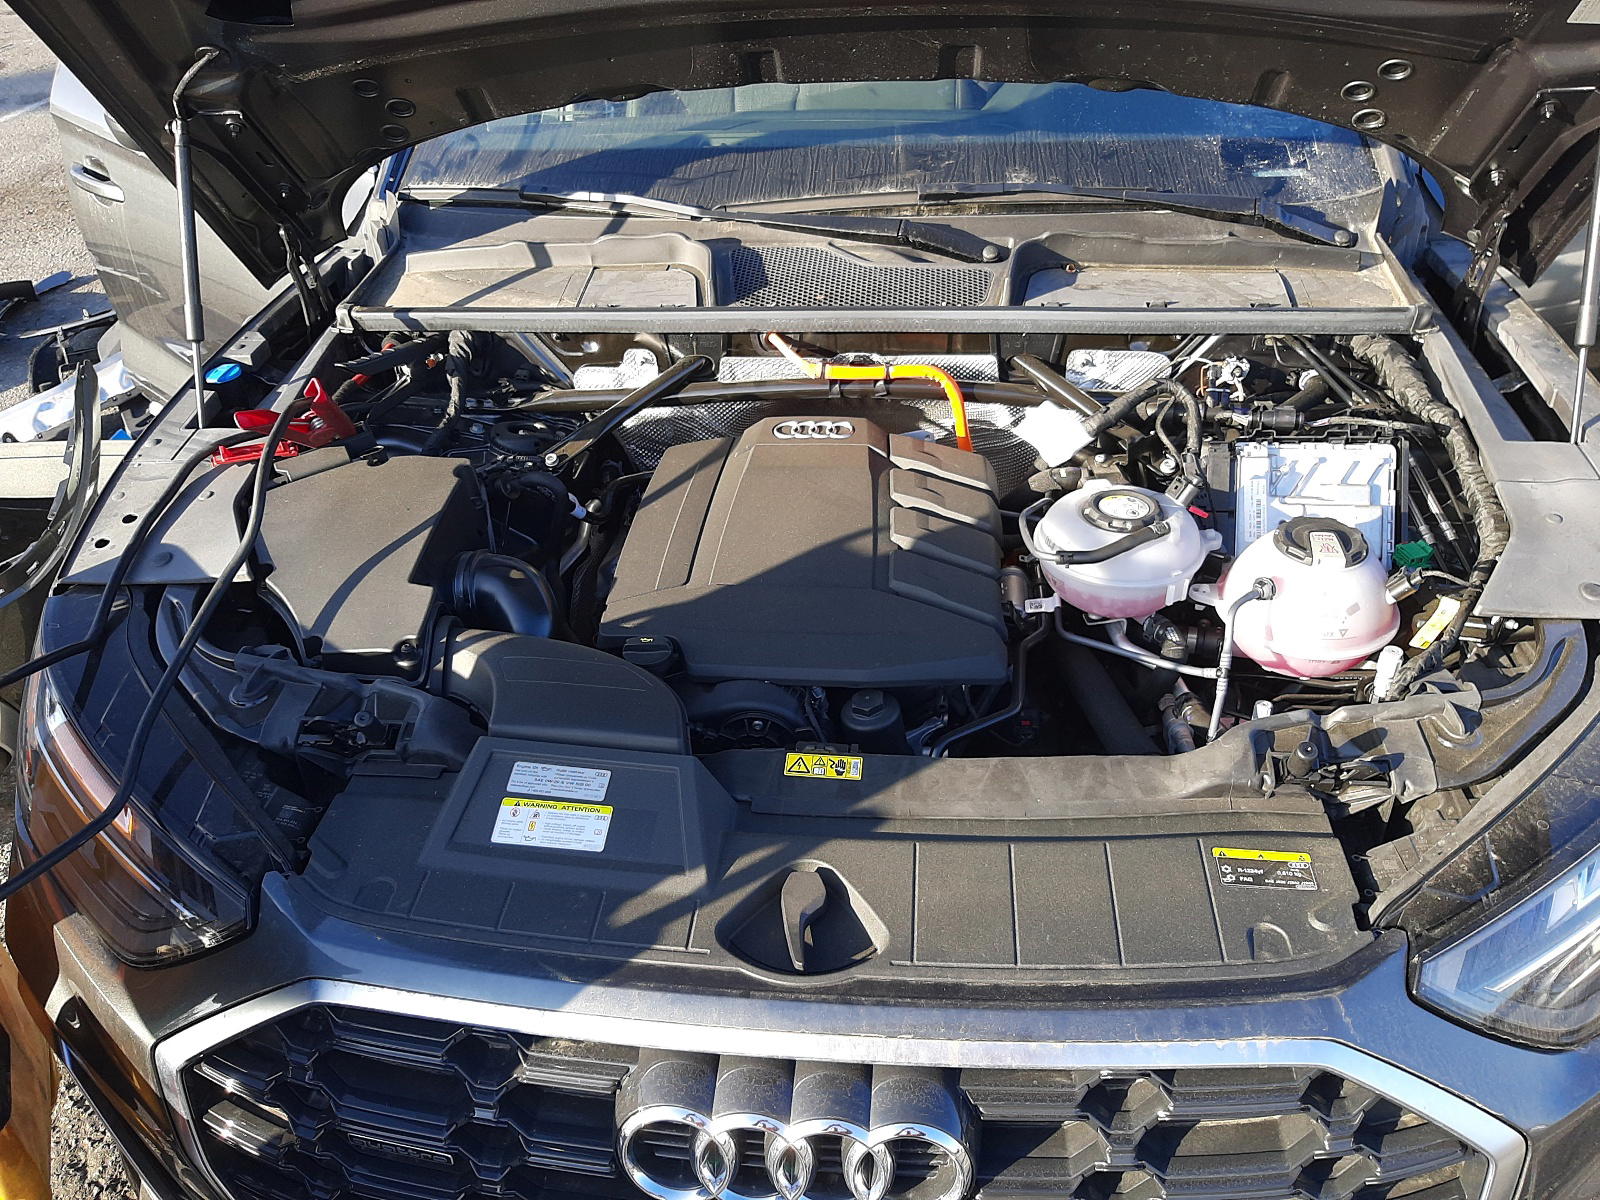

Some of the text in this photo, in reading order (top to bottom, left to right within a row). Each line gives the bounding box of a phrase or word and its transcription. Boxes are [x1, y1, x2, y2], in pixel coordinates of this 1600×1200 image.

[523, 801, 601, 813] WARNING ATTENTION
[351, 1137, 447, 1162] quattro
